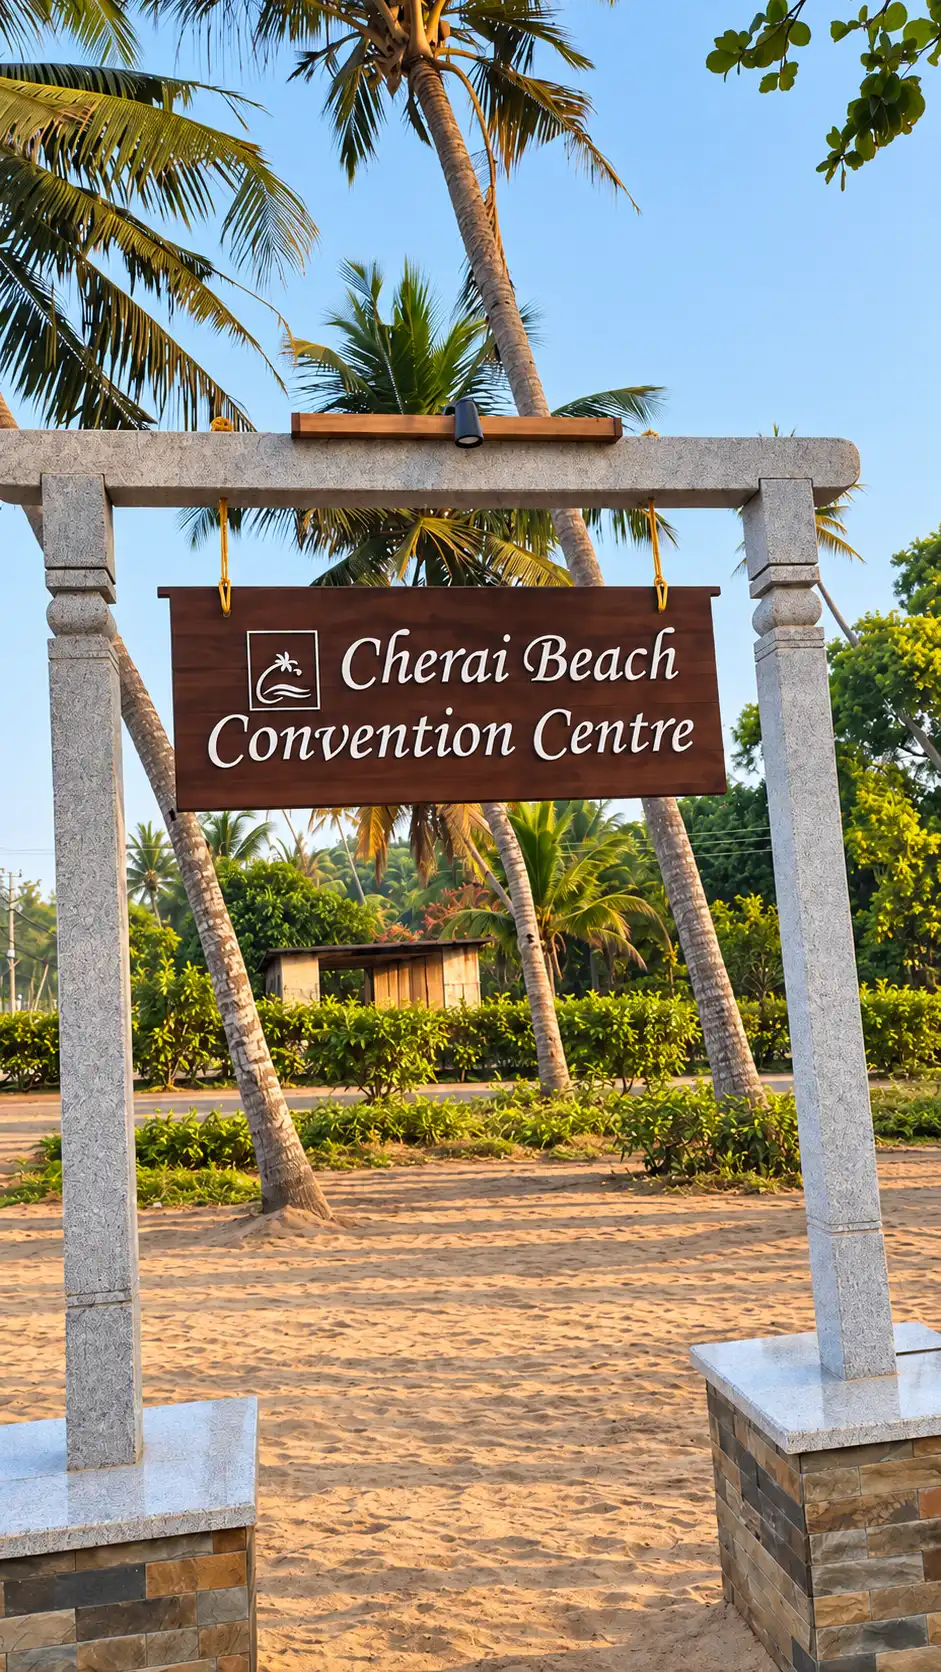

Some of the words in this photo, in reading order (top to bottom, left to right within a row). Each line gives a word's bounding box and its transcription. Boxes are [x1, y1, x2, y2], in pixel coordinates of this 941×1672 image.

[341, 628, 511, 690] Cherai
[523, 627, 679, 682] Beach
[208, 707, 516, 768] Convention
[533, 708, 694, 761] Centre
